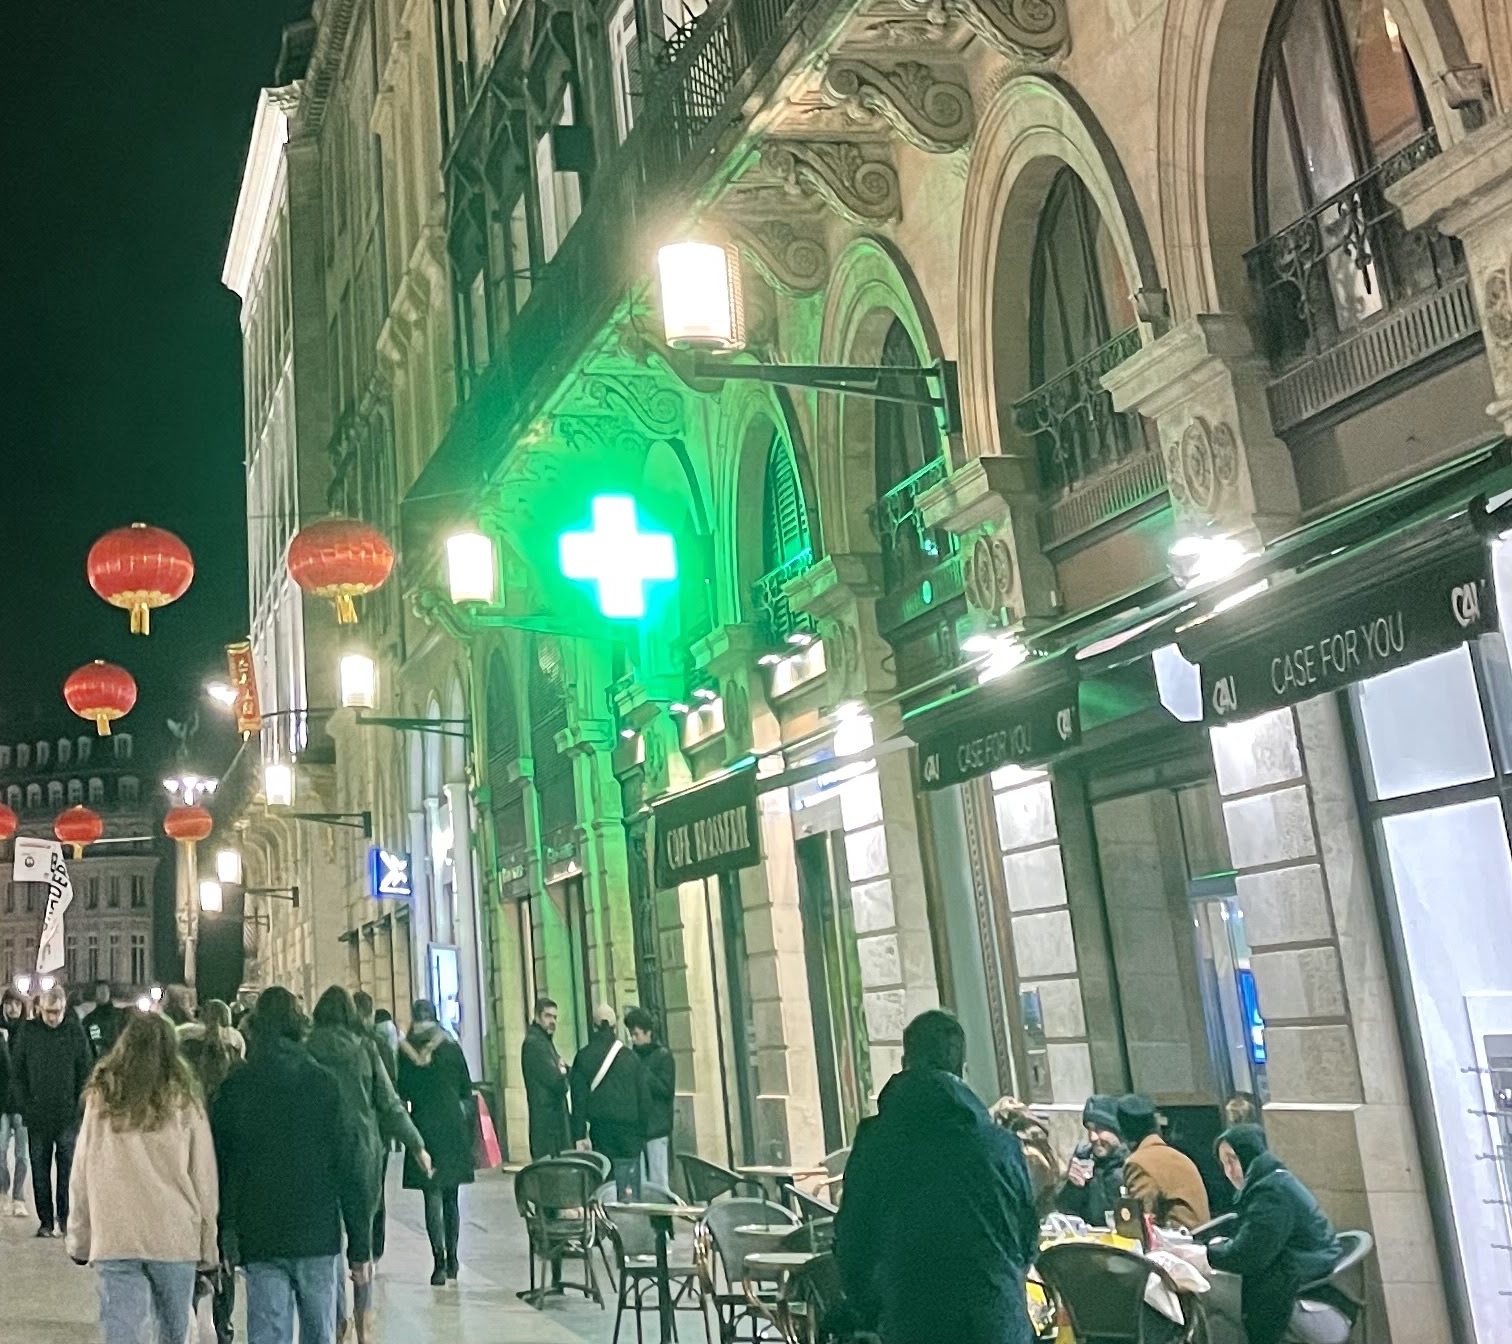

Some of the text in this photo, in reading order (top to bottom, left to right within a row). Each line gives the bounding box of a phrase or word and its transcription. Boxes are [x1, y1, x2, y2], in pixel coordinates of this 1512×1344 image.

[1270, 611, 1405, 694] CASE FOR YOU
